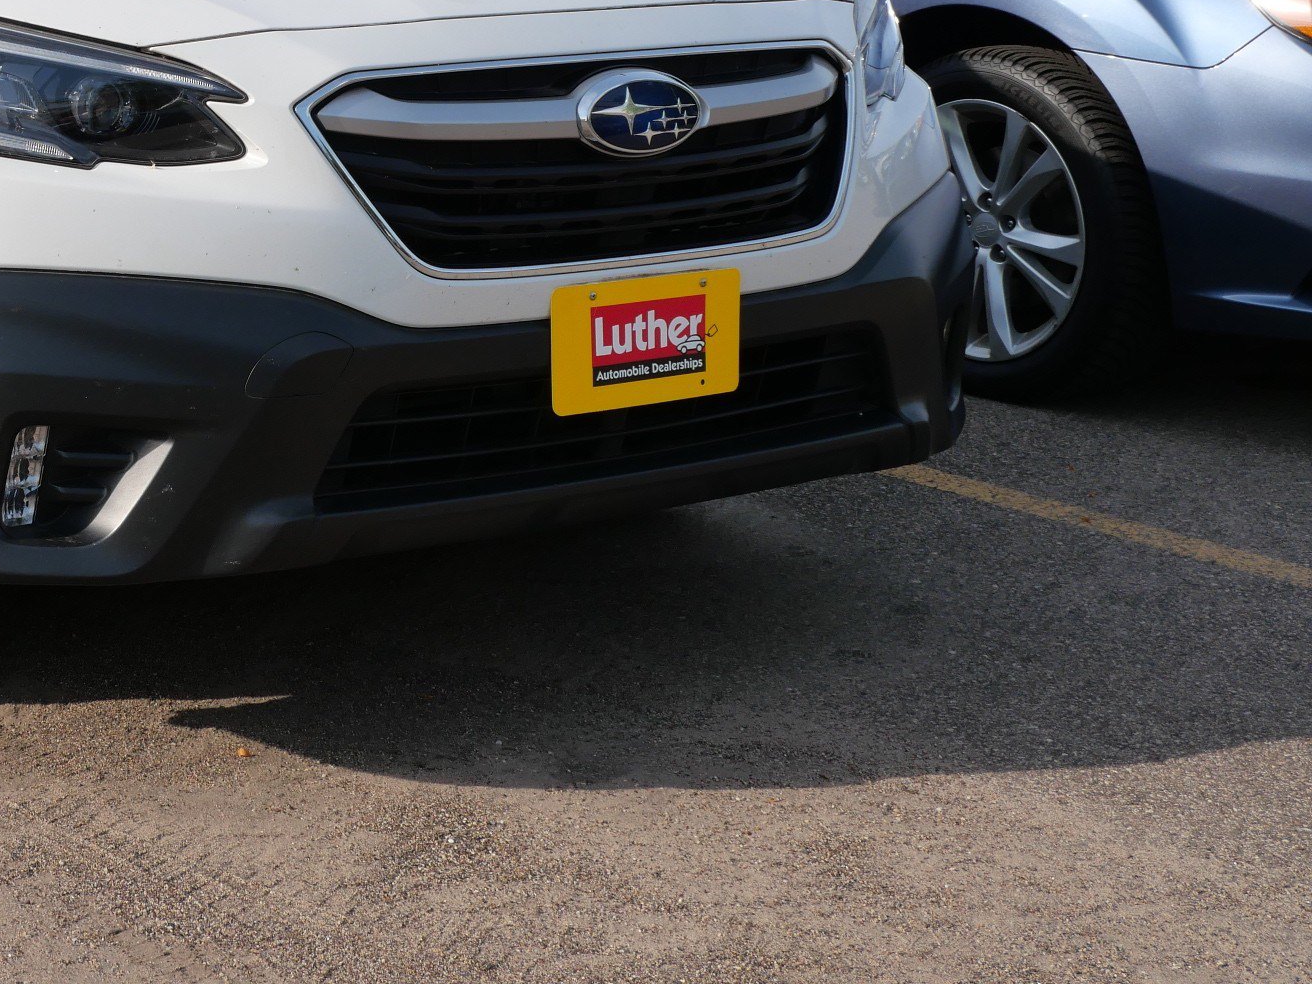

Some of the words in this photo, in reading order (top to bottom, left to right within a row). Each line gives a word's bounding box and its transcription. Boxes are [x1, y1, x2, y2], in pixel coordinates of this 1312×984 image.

[594, 309, 703, 357] Luther
[596, 364, 650, 382] Automobile
[652, 357, 703, 373] Dealerships
